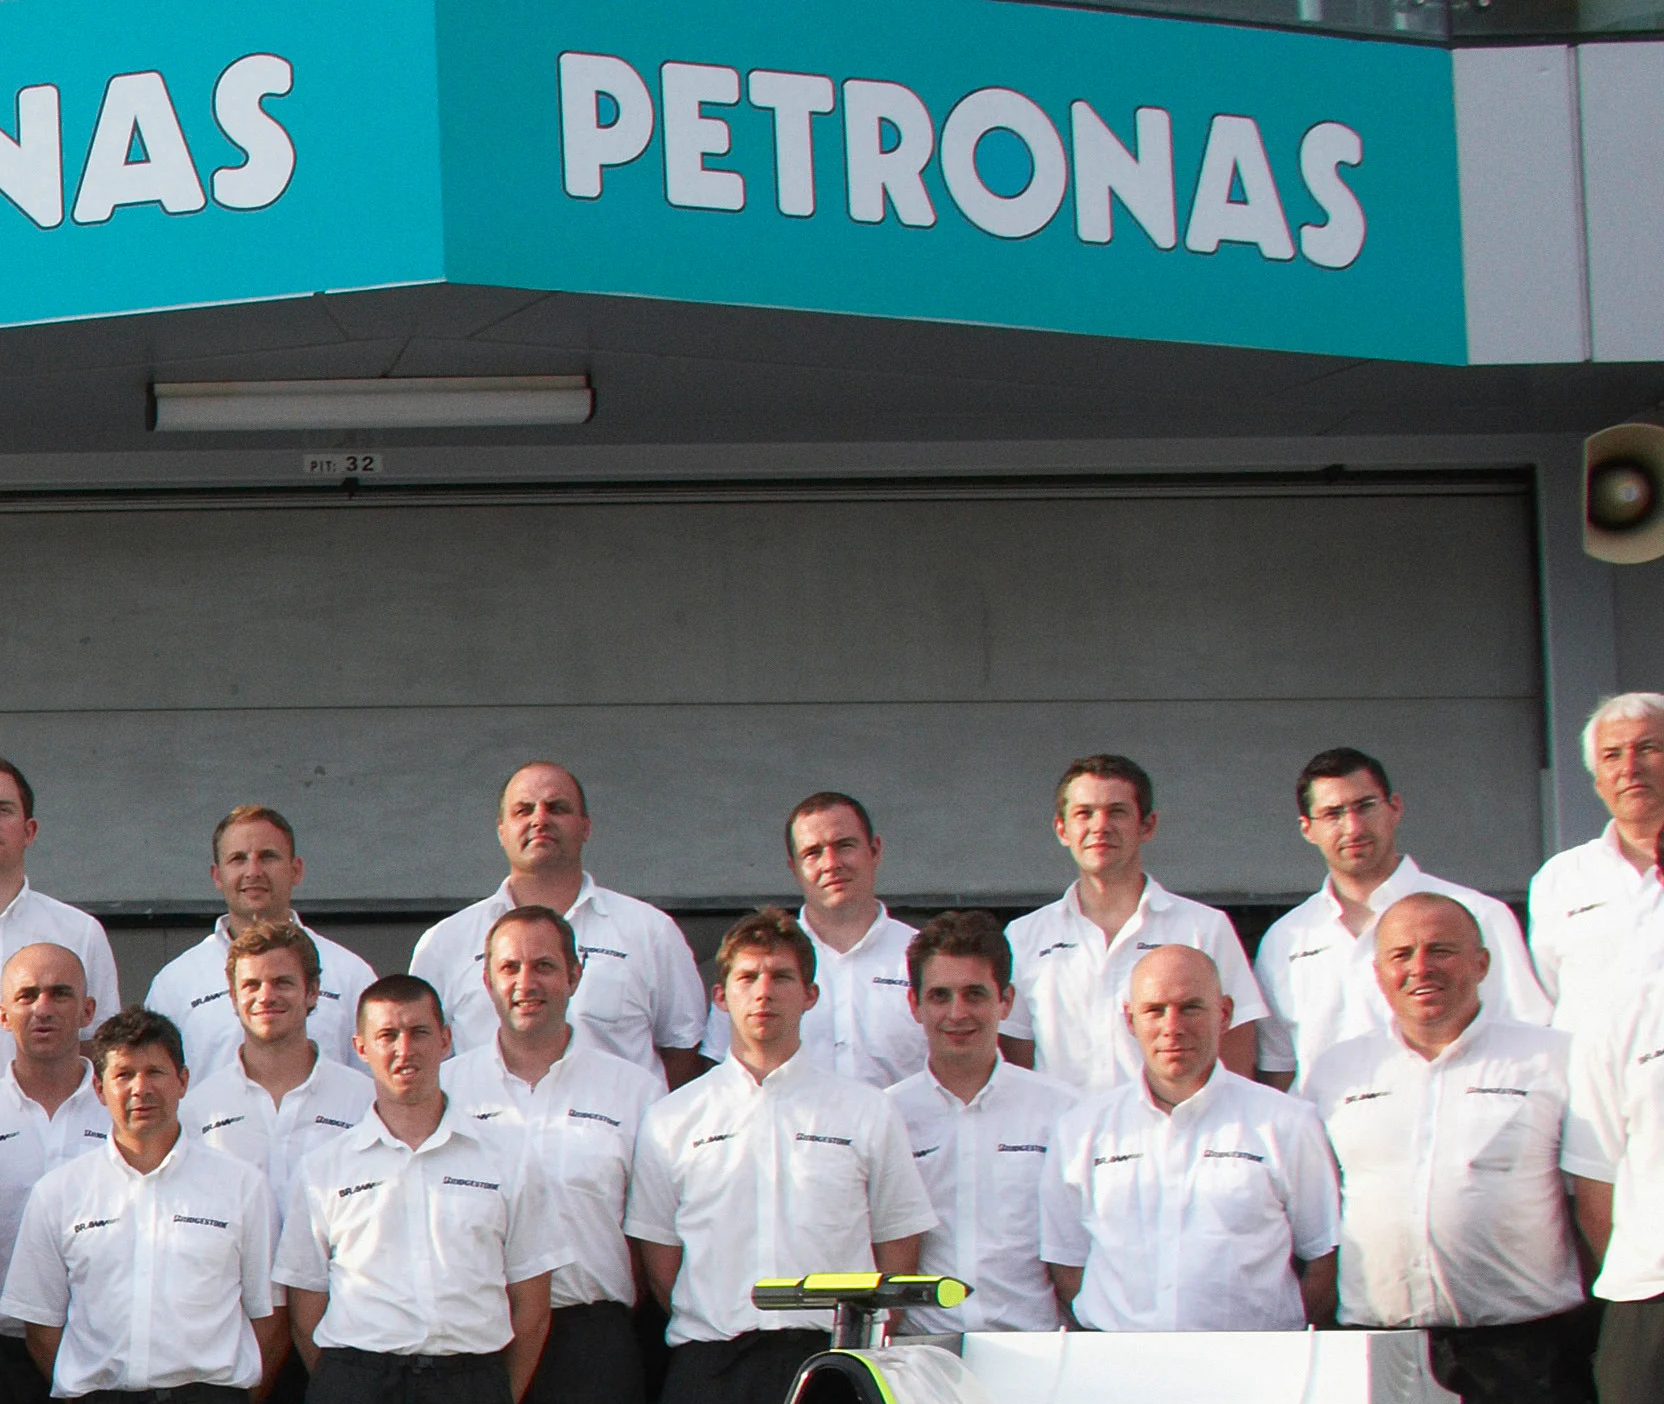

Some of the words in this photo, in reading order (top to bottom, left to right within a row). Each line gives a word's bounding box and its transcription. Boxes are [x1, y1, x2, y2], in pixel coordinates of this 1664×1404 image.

[557, 50, 1365, 269] PETRONAS
[310, 460, 336, 472] PIT:
[346, 456, 373, 471] 32
